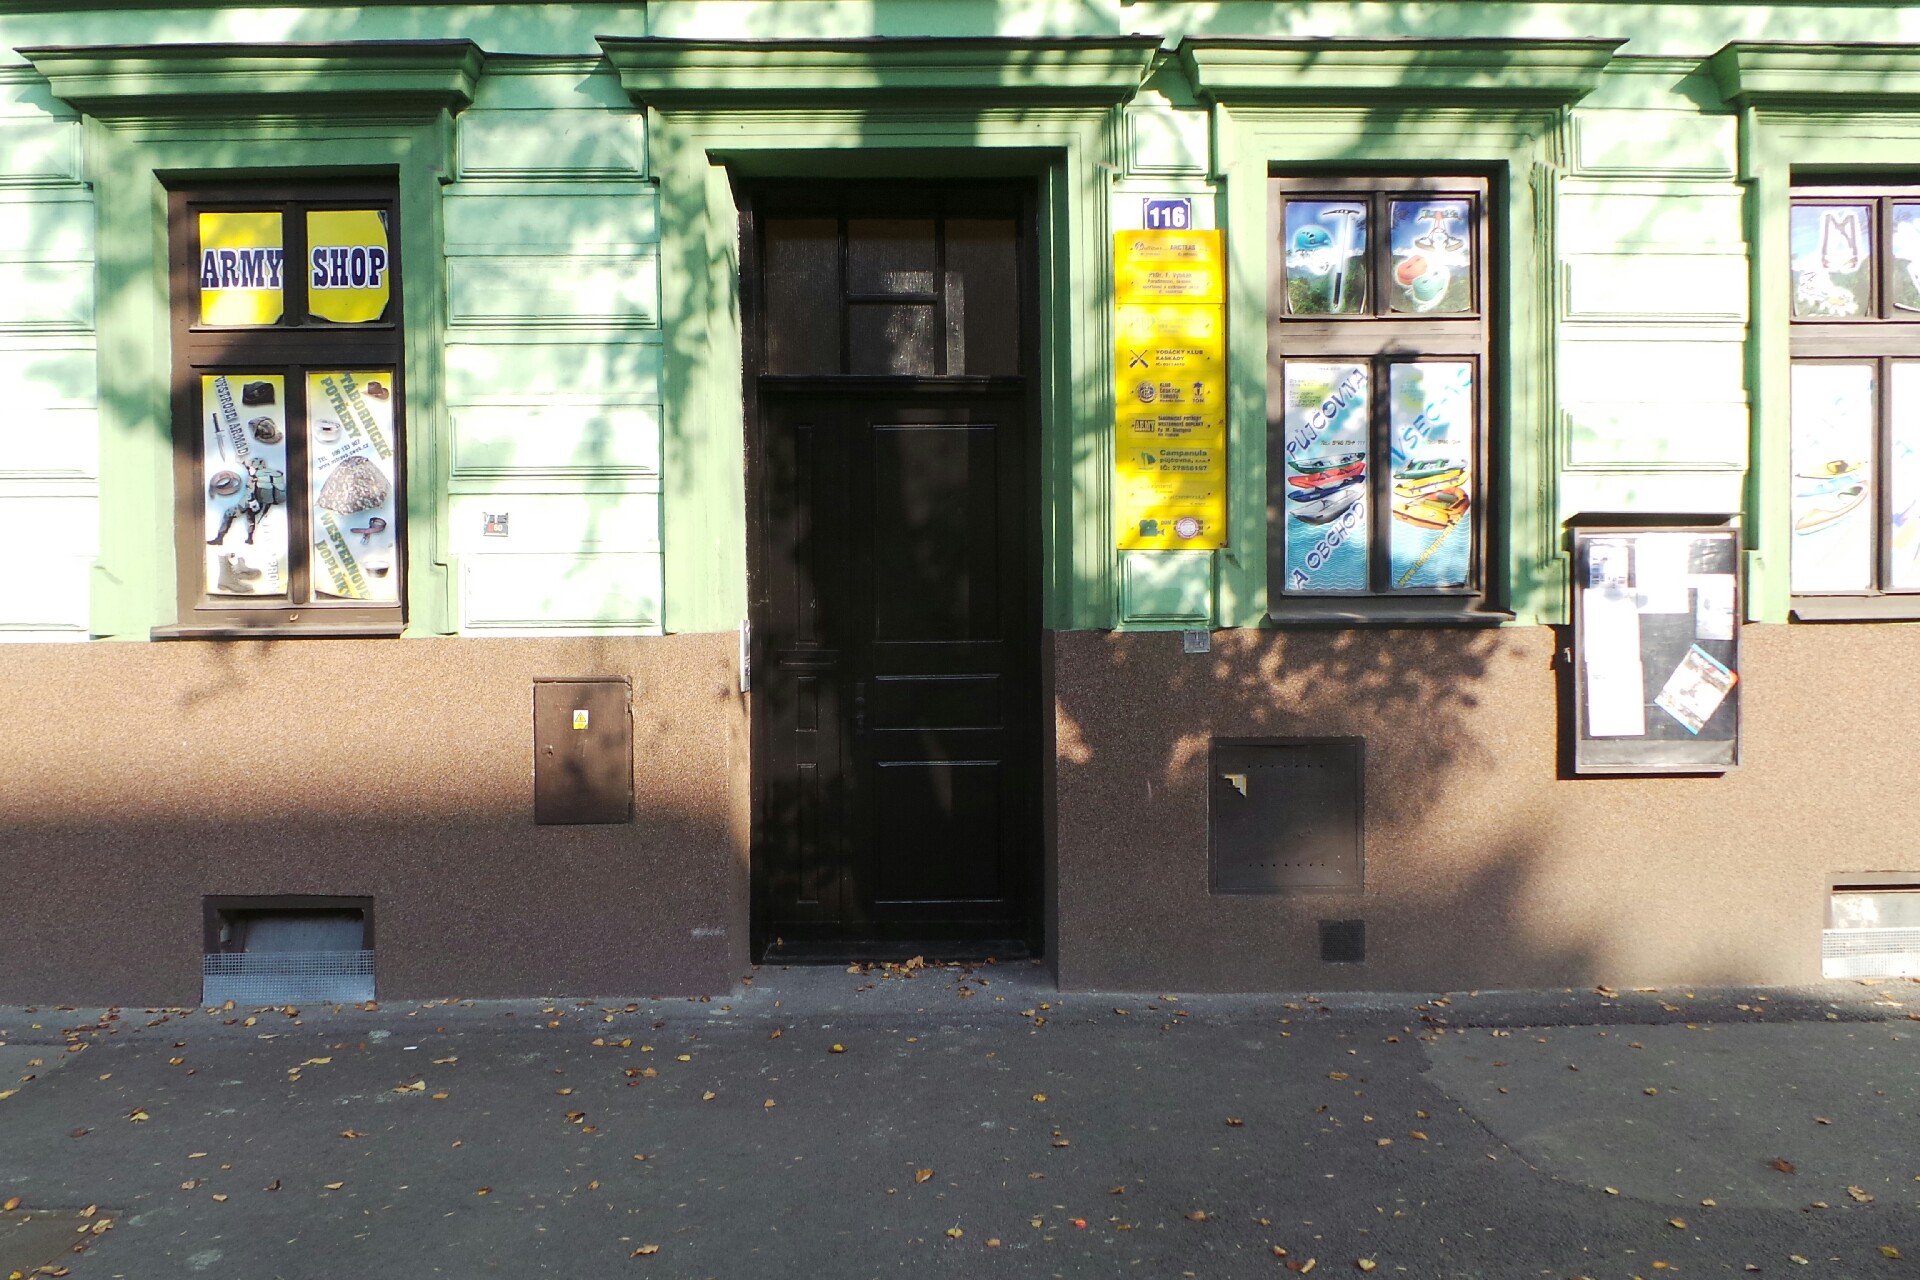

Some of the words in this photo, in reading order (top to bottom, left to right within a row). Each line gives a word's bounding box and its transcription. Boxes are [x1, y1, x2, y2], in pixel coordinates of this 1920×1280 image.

[1149, 206, 1186, 228] 116
[201, 249, 284, 288] ARMY
[313, 247, 386, 288] SHOP
[321, 376, 362, 439] POTŘEBY
[339, 372, 393, 461] TÁBORNICKÉ
[1135, 420, 1155, 432] ARMY
[1286, 368, 1368, 461] PŮJČOVNA
[1160, 449, 1207, 457] Campanula
[1292, 569, 1309, 590] A
[1307, 502, 1365, 569] OBCHOD
